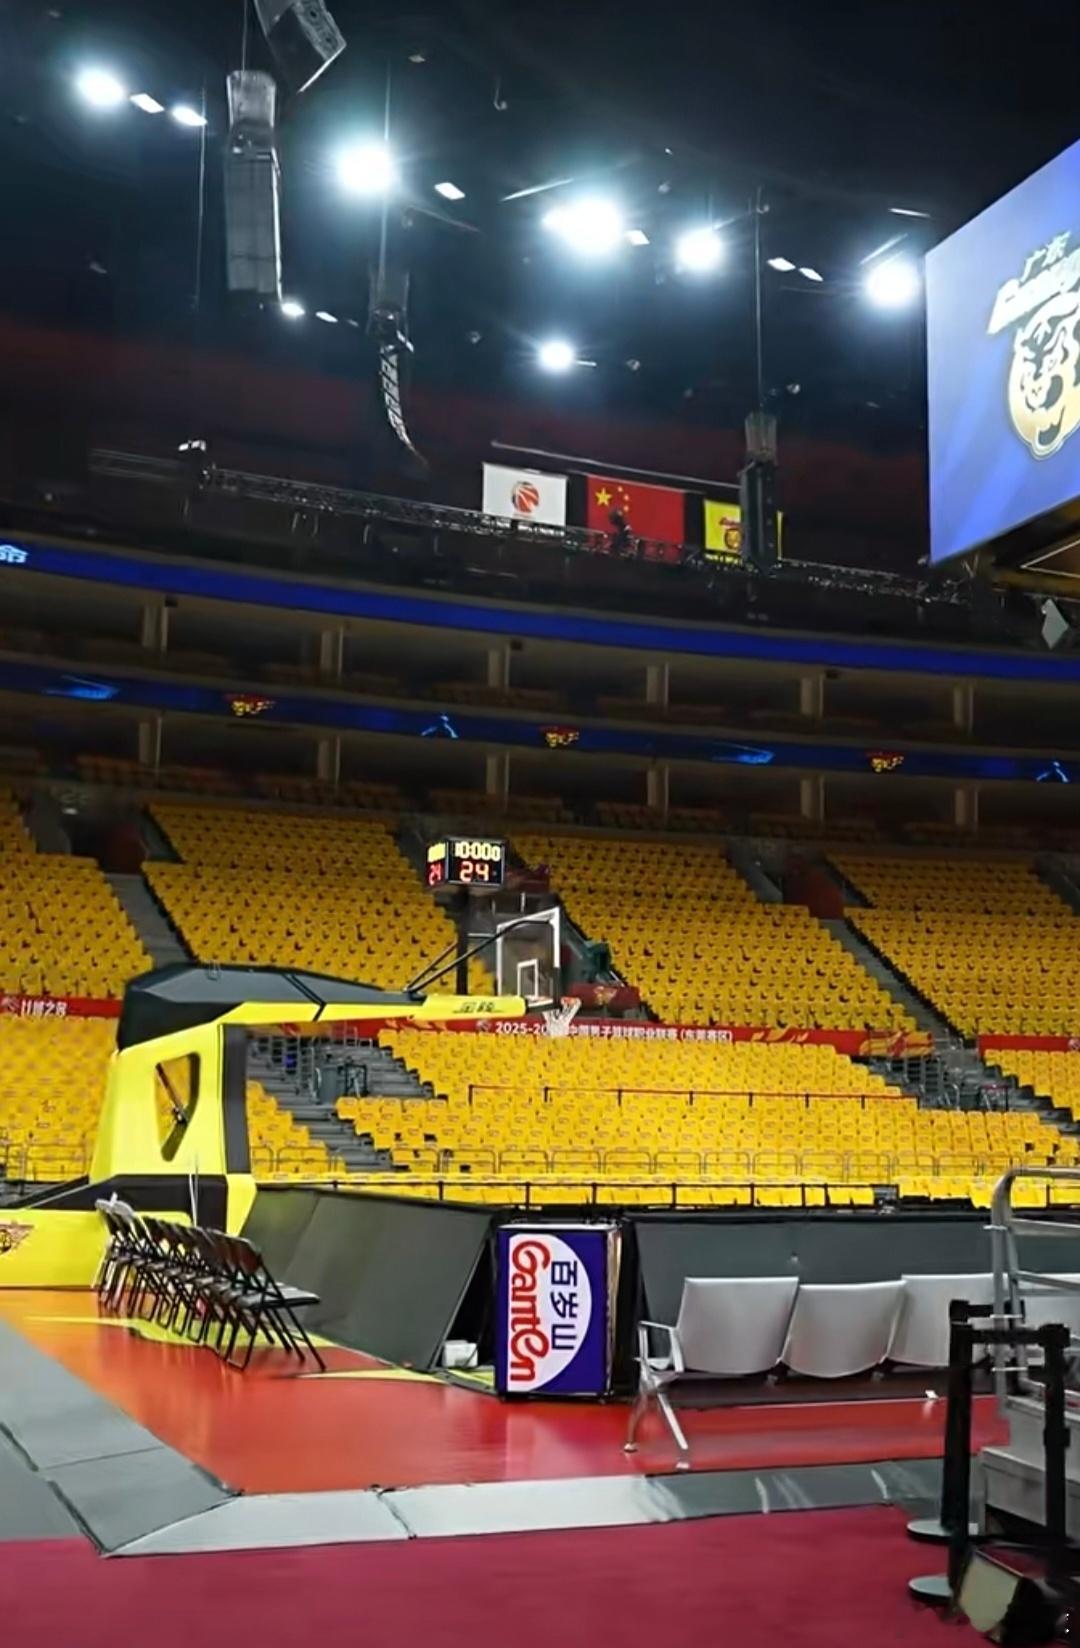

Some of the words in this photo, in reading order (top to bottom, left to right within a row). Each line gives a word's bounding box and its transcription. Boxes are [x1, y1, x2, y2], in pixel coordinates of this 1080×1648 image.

[459, 861, 490, 882] 24
[550, 1259, 579, 1351] 百岁山
